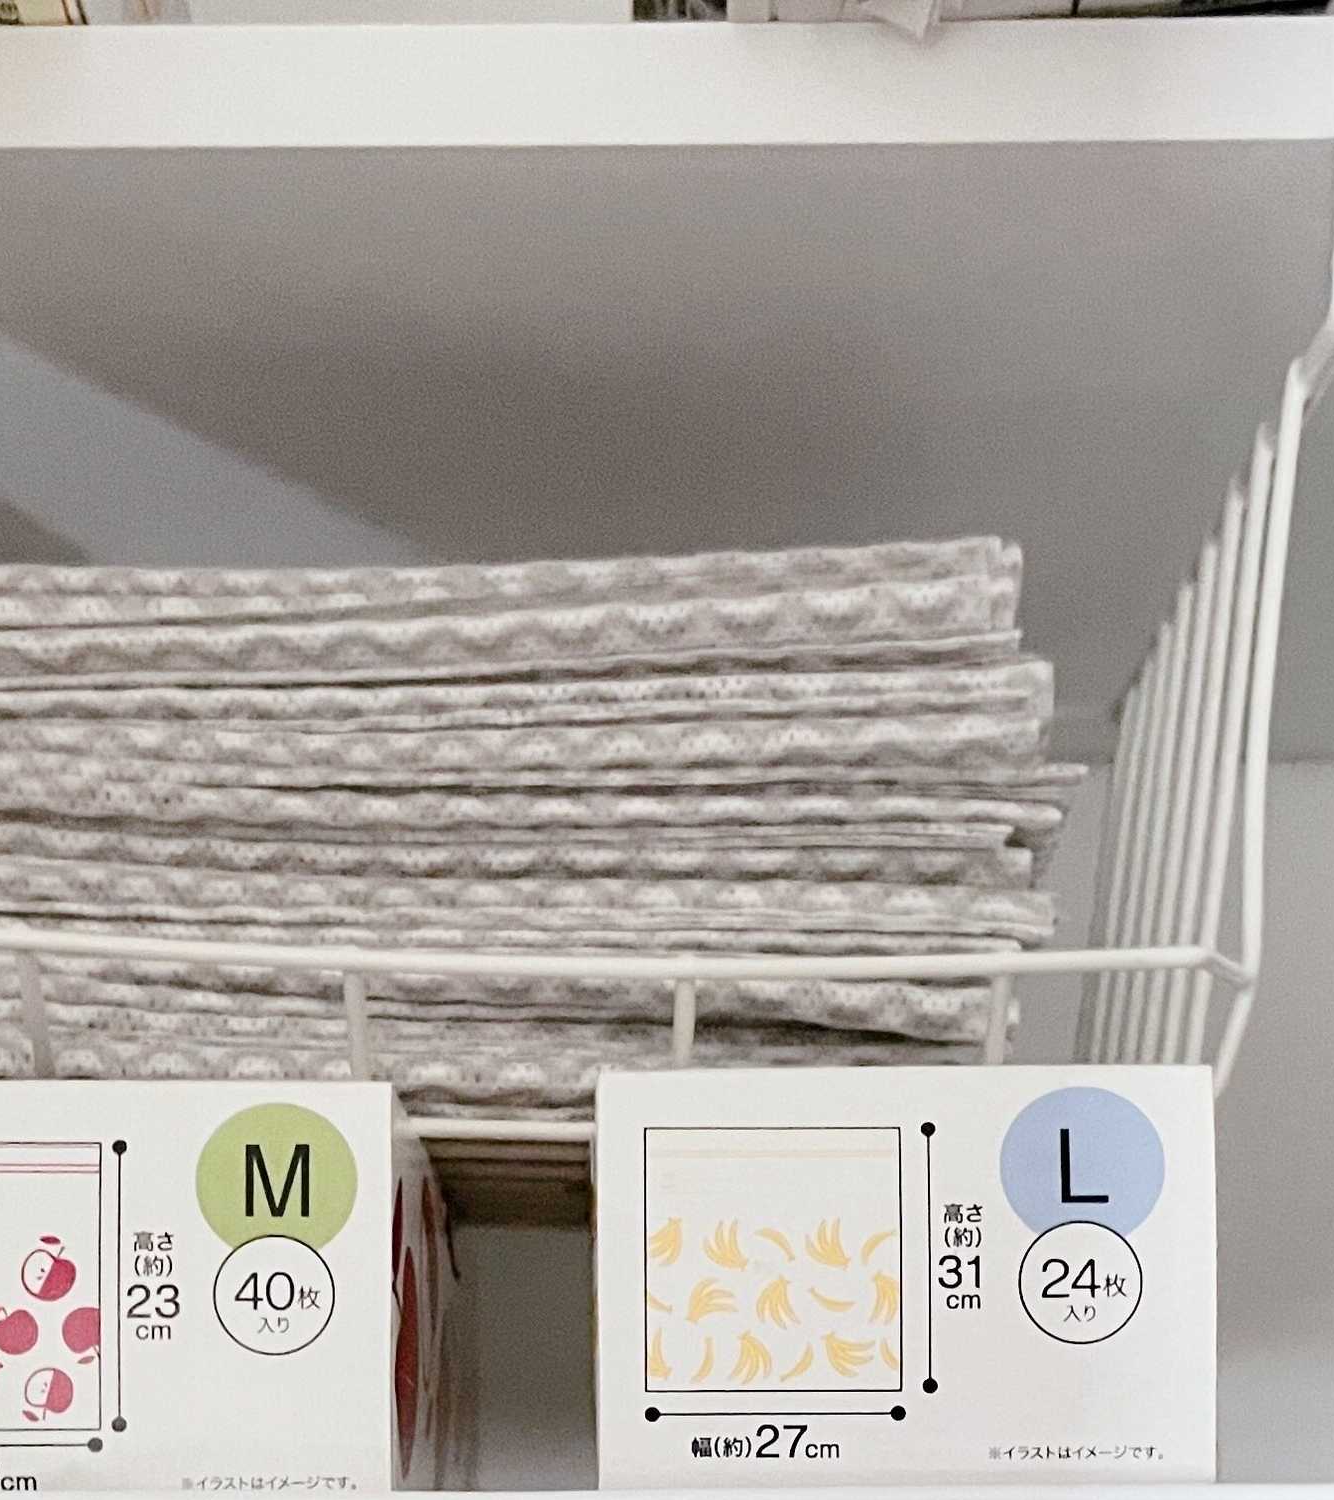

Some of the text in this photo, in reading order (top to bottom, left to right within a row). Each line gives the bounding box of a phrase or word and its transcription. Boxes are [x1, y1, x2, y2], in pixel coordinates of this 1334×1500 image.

[1060, 1128, 1109, 1203] L
[244, 1143, 310, 1218] M
[944, 1204, 983, 1223] 高さ
[133, 1231, 174, 1251] 高さ
[938, 1255, 981, 1289] 31
[1041, 1258, 1127, 1298] 24枚
[126, 1284, 180, 1318] 23
[234, 1271, 321, 1311] 40枚
[946, 1294, 981, 1309] cm
[257, 1317, 290, 1334] 入り
[1063, 1305, 1097, 1323] 入り
[135, 1324, 171, 1340] cm
